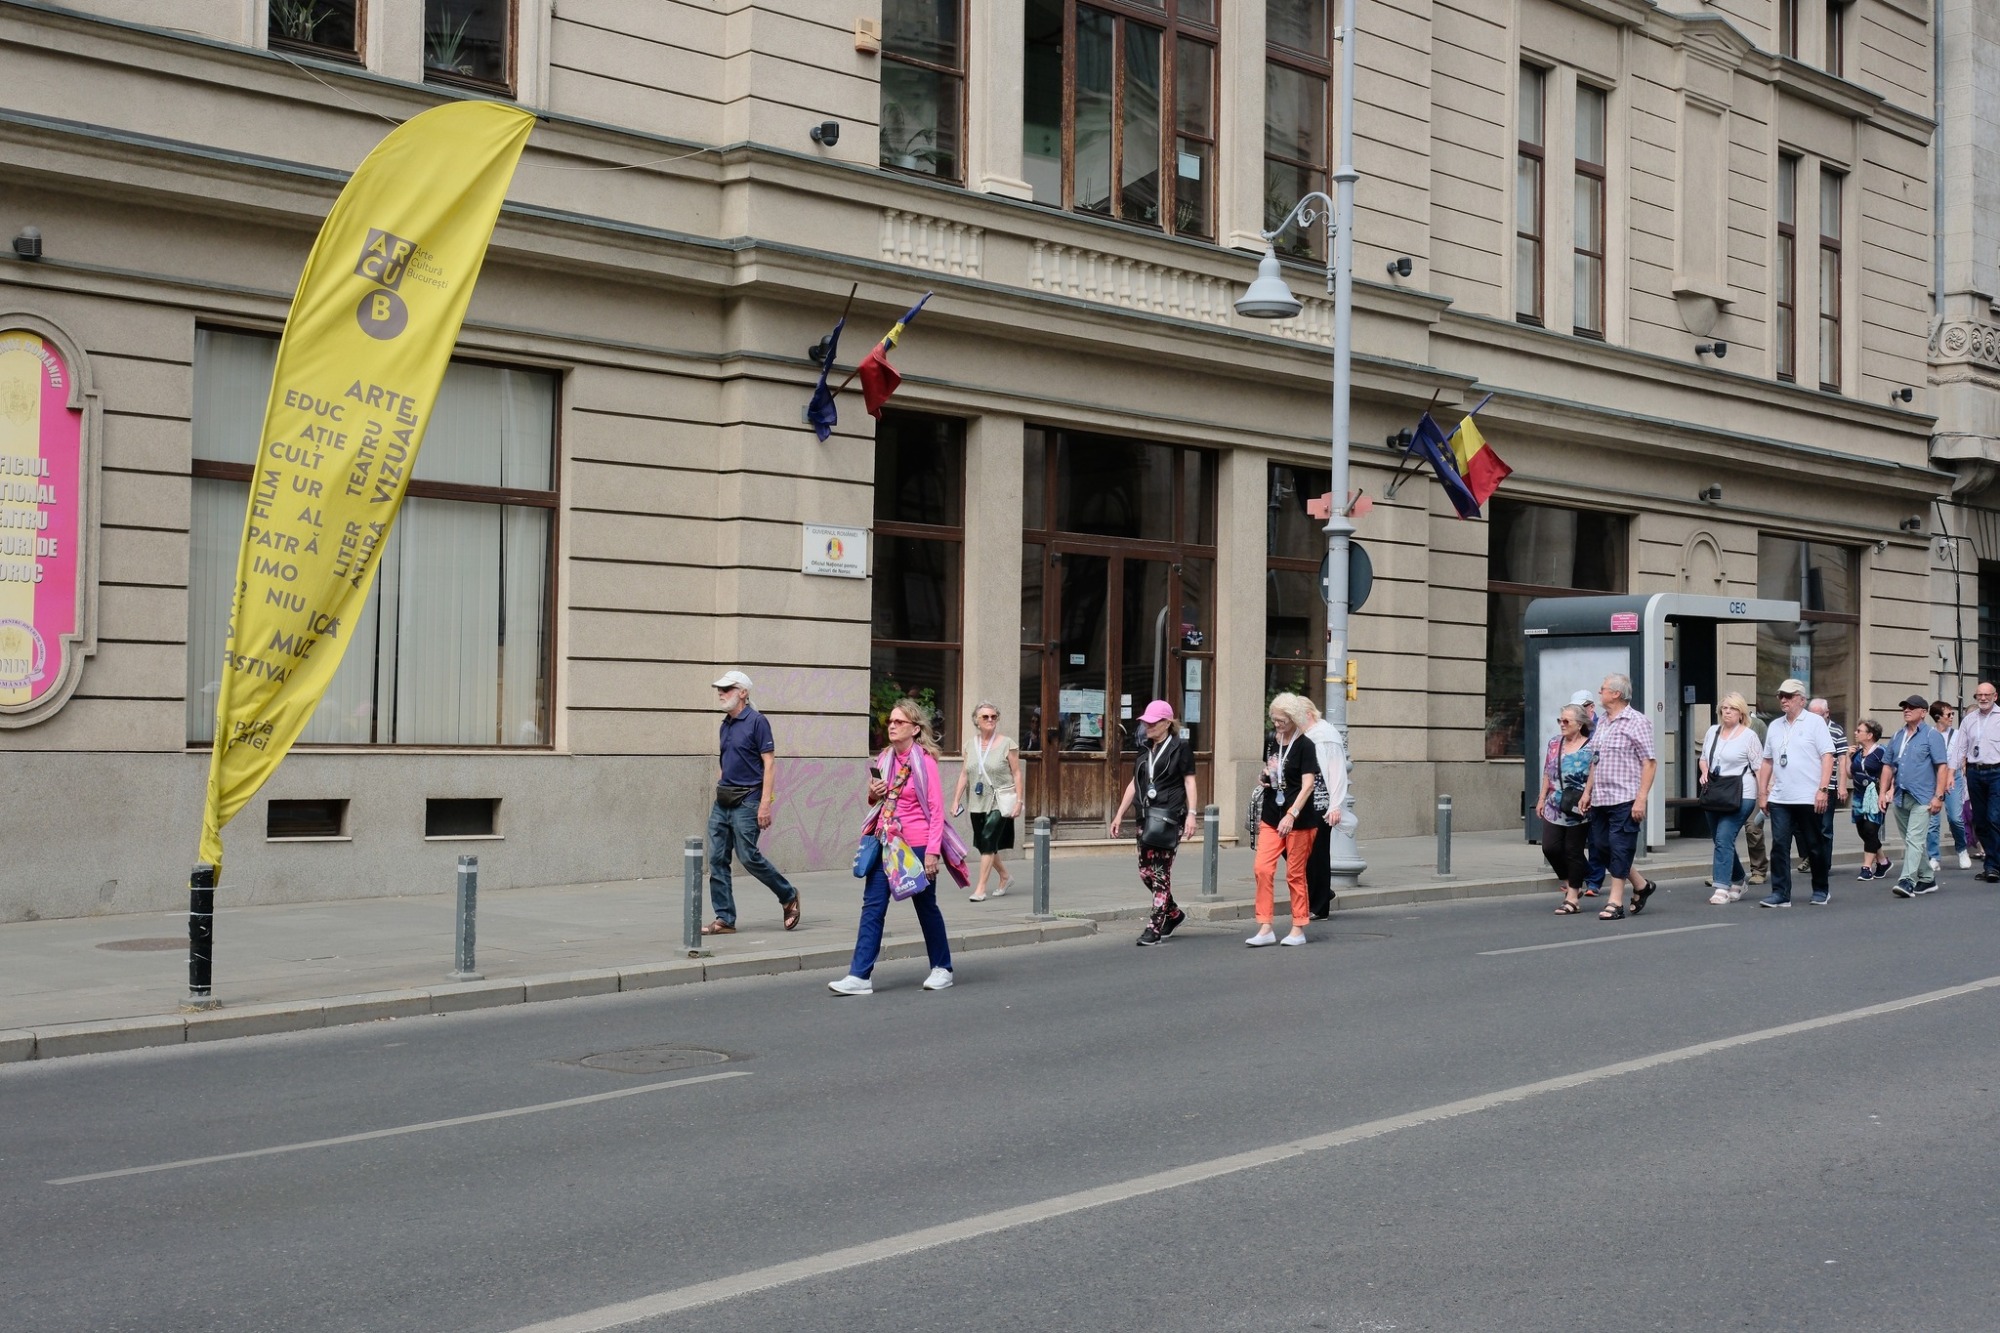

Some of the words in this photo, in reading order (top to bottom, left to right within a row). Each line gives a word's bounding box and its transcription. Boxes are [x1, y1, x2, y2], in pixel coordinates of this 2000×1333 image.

[411, 257, 443, 276] Cultură
[416, 247, 434, 261] Arte
[407, 268, 449, 289] București
[284, 389, 346, 422] EDUC
[344, 379, 416, 419] ARTE
[299, 424, 348, 451] AȚIE
[269, 442, 325, 470] CULT
[346, 420, 383, 497] TEATRU
[252, 470, 282, 520] FILM
[292, 475, 323, 499] UR
[297, 506, 323, 528] AL
[36, 537, 58, 558] DE
[247, 525, 300, 555] PATR
[333, 521, 362, 578] LITER
[253, 555, 298, 582] IMO
[265, 587, 306, 613] NIU
[1729, 601, 1746, 614] CEC
[269, 629, 316, 659] MUZ
[0, 680, 28, 688] MÂNIA
